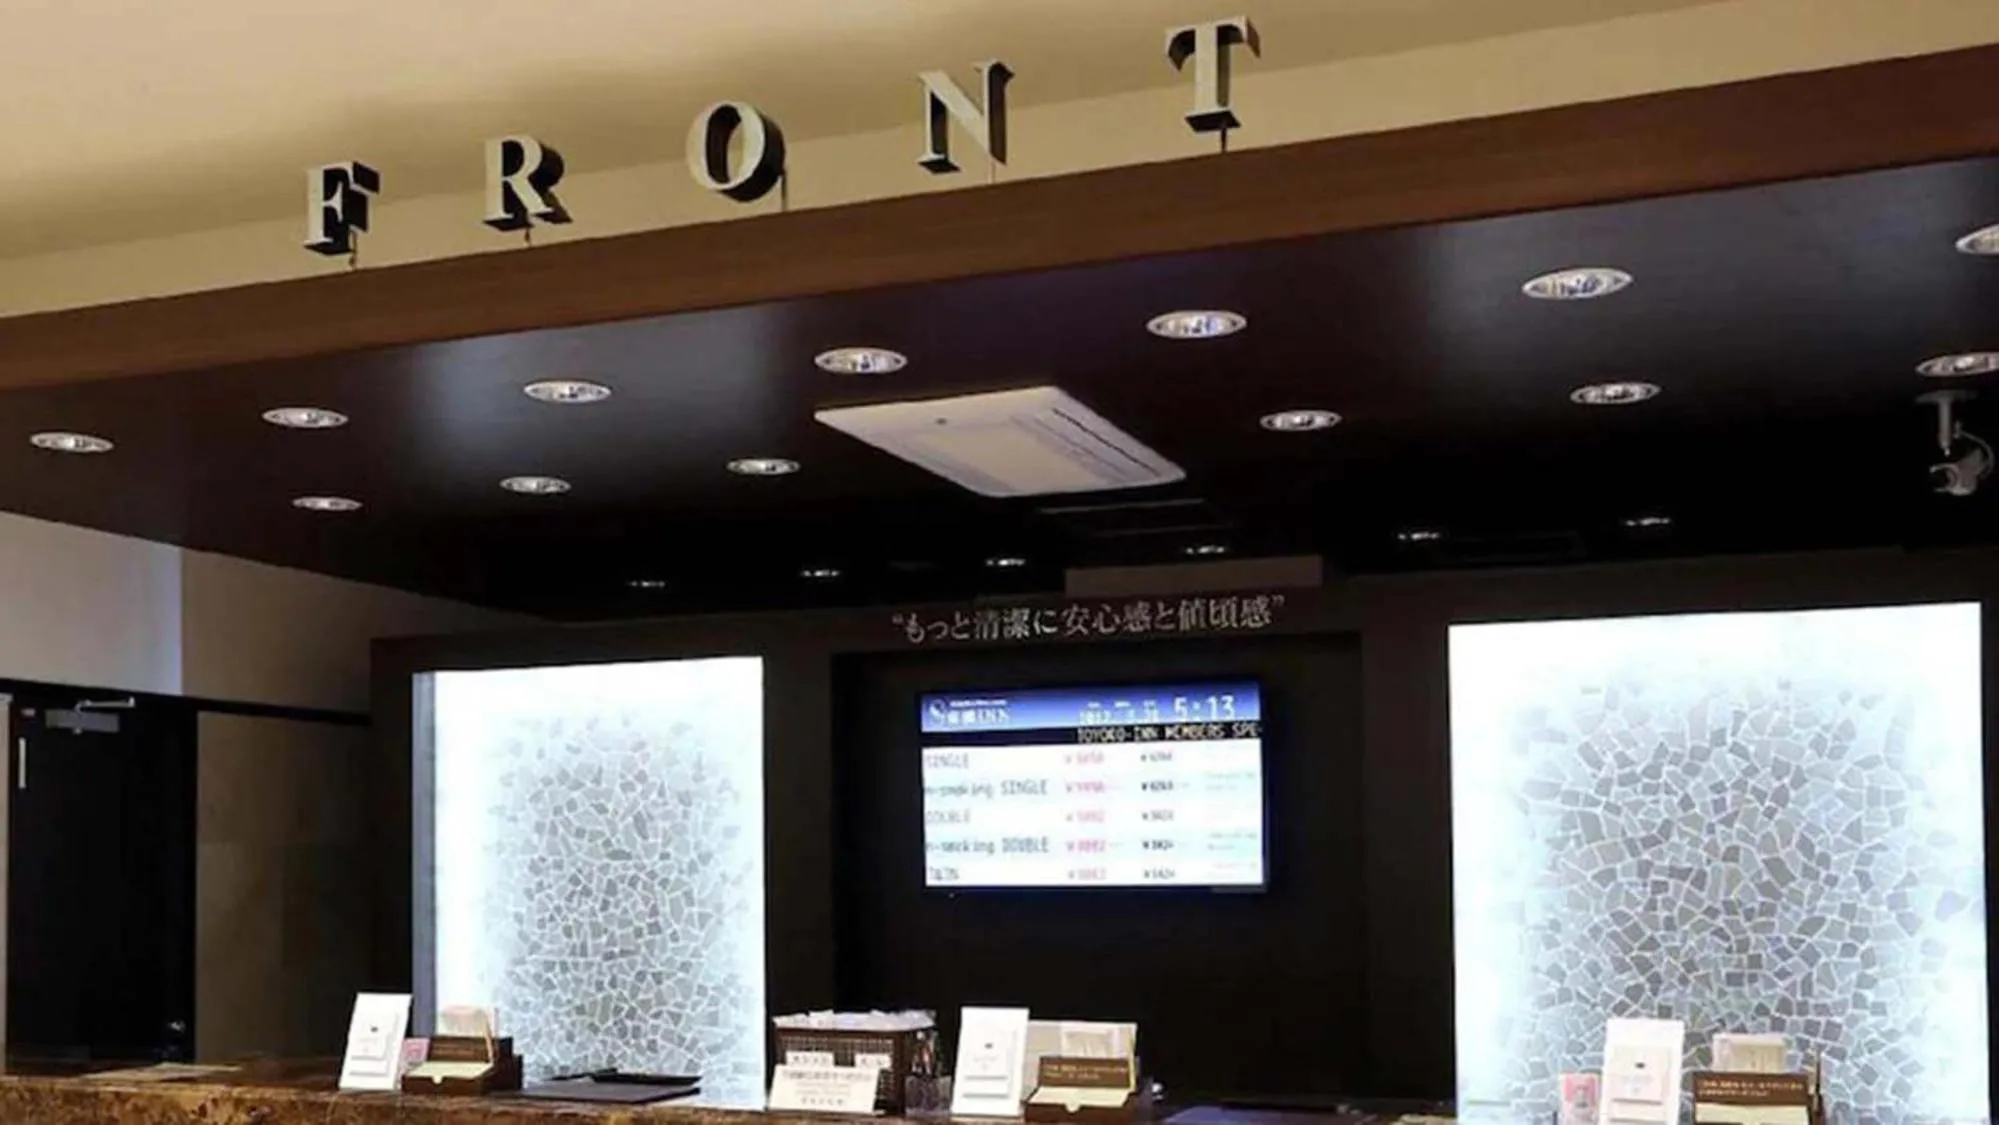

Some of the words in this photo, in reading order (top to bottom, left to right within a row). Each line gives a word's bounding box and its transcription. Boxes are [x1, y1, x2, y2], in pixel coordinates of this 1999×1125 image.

[304, 14, 1262, 255] FRONT
[1173, 695, 1236, 722] 5:13
[1000, 778, 1049, 796] SINGLE
[1002, 835, 1050, 854] DOUBLE
